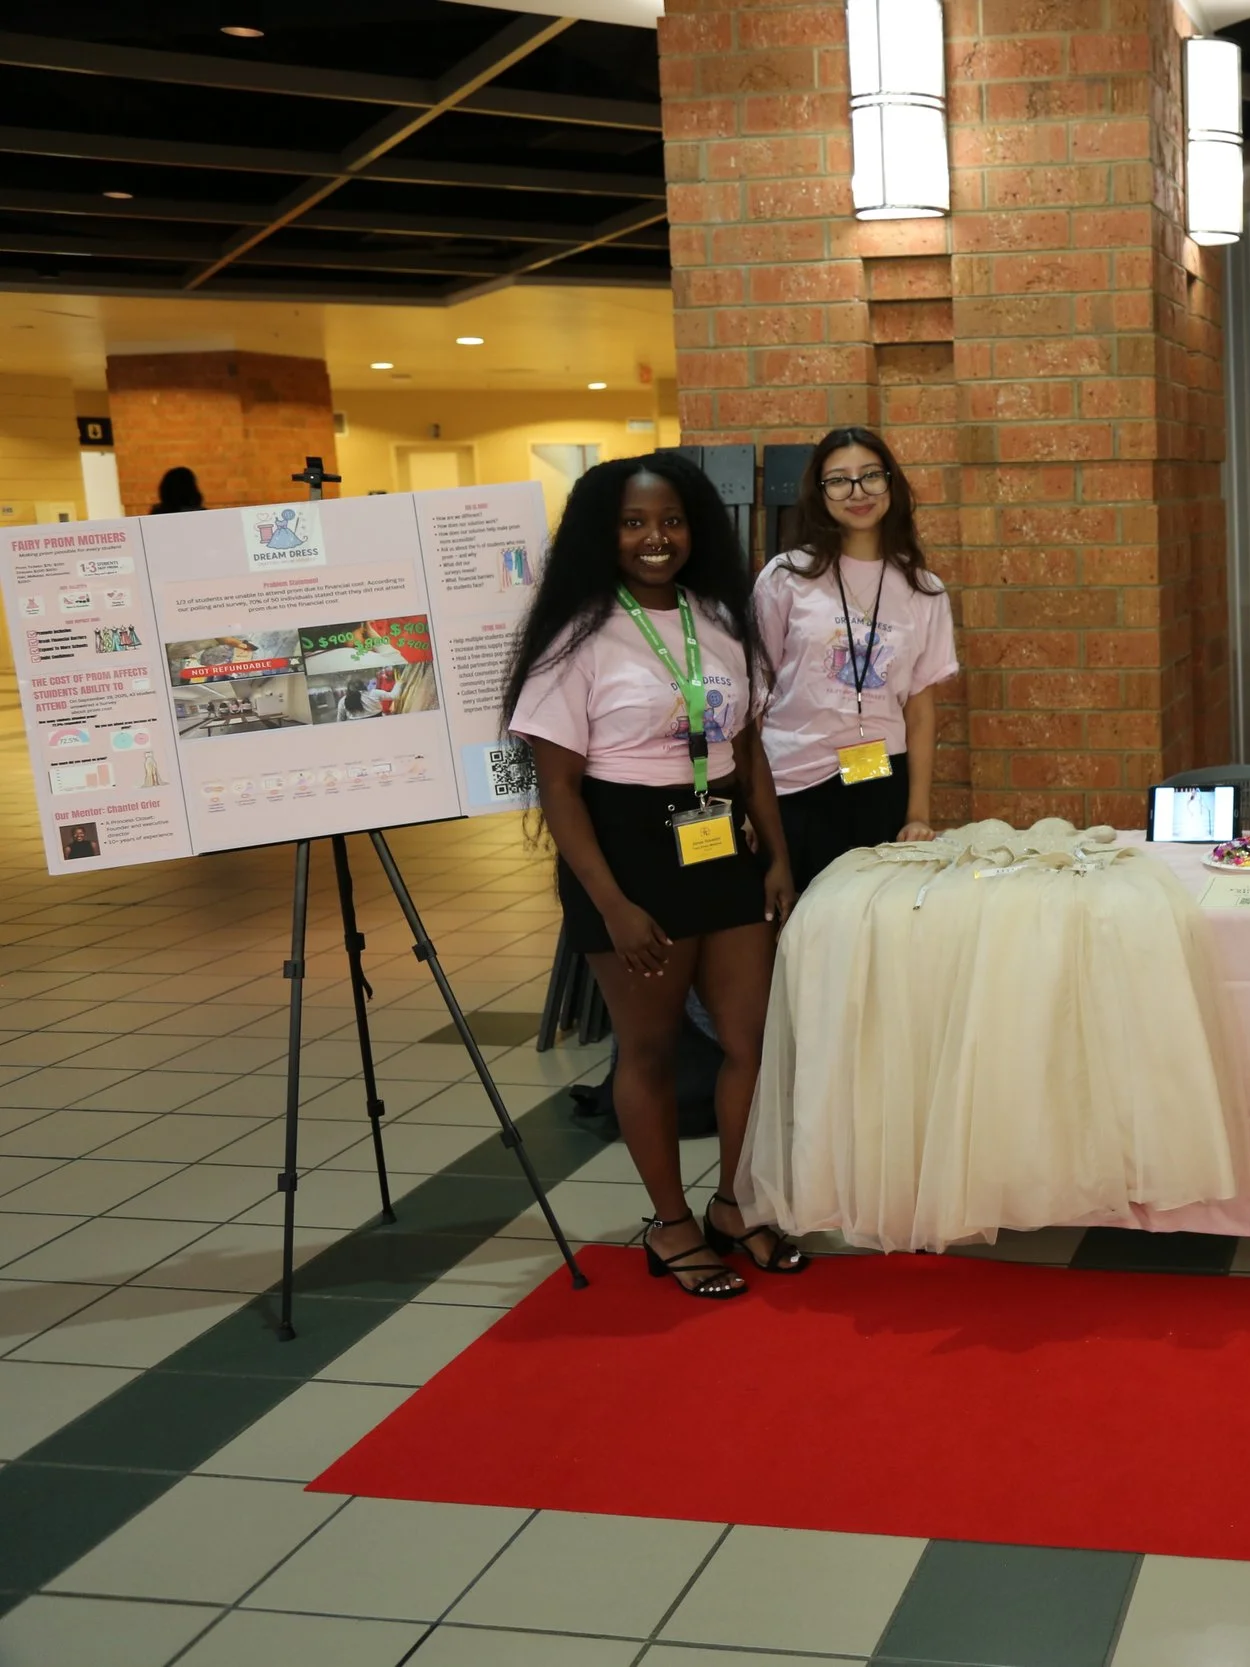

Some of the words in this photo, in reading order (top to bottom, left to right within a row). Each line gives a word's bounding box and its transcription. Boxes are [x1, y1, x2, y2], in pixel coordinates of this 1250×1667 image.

[12, 540, 41, 551] FAIRY
[44, 536, 75, 549] PROM
[78, 532, 127, 546] MOTHERS
[253, 551, 287, 561] DREAM
[289, 548, 319, 558] DRESS
[190, 604, 212, 612] polling
[280, 594, 313, 602] individuals
[385, 583, 406, 591] attend
[195, 596, 223, 604] students
[325, 582, 350, 590] financial
[367, 578, 397, 586] According
[318, 631, 354, 648] $900
[191, 668, 209, 676] NOT
[212, 660, 272, 673] REFUNDABLE
[32, 678, 47, 687] THE
[49, 676, 70, 686] COST
[73, 674, 83, 683] OF
[85, 671, 111, 681] PROM
[113, 667, 148, 678] AFFECTS
[702, 676, 732, 687] DRESS
[81, 683, 110, 694] ABILITY
[113, 681, 124, 691] TO
[36, 701, 67, 712] ATTEND
[54, 811, 70, 821] Our
[71, 807, 106, 819] Mentor:
[107, 802, 139, 814] Chantel
[141, 799, 161, 810] Grier
[143, 832, 173, 840] experience
